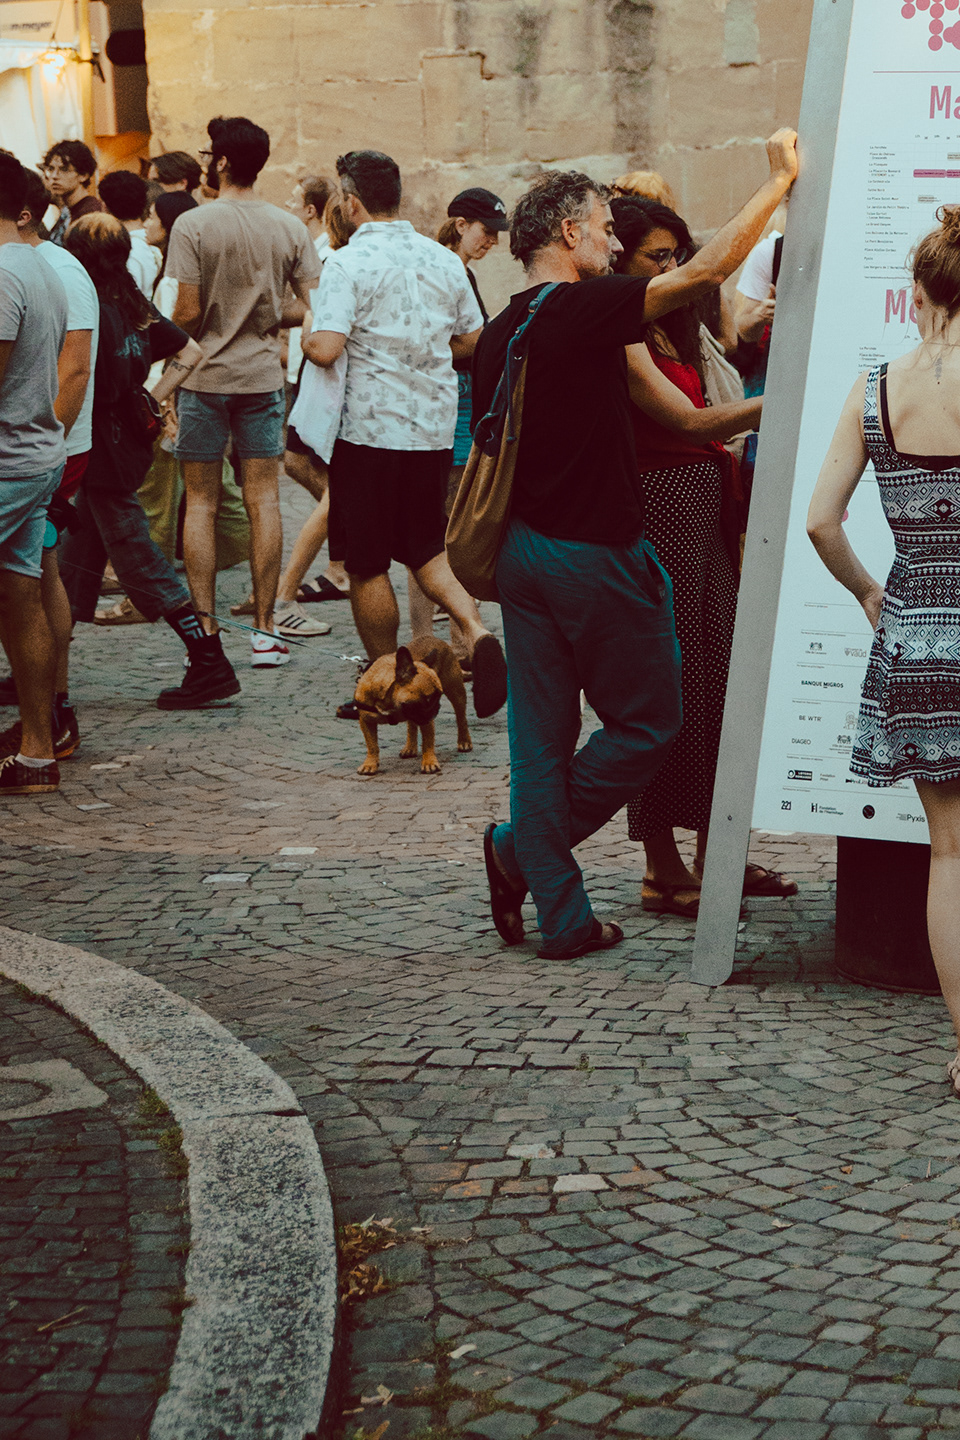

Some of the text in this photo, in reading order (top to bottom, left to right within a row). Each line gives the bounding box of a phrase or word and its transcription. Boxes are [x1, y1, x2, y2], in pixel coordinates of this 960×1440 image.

[801, 679, 844, 689] BANQUE MIGROS
[906, 813, 926, 823] Pyxis
